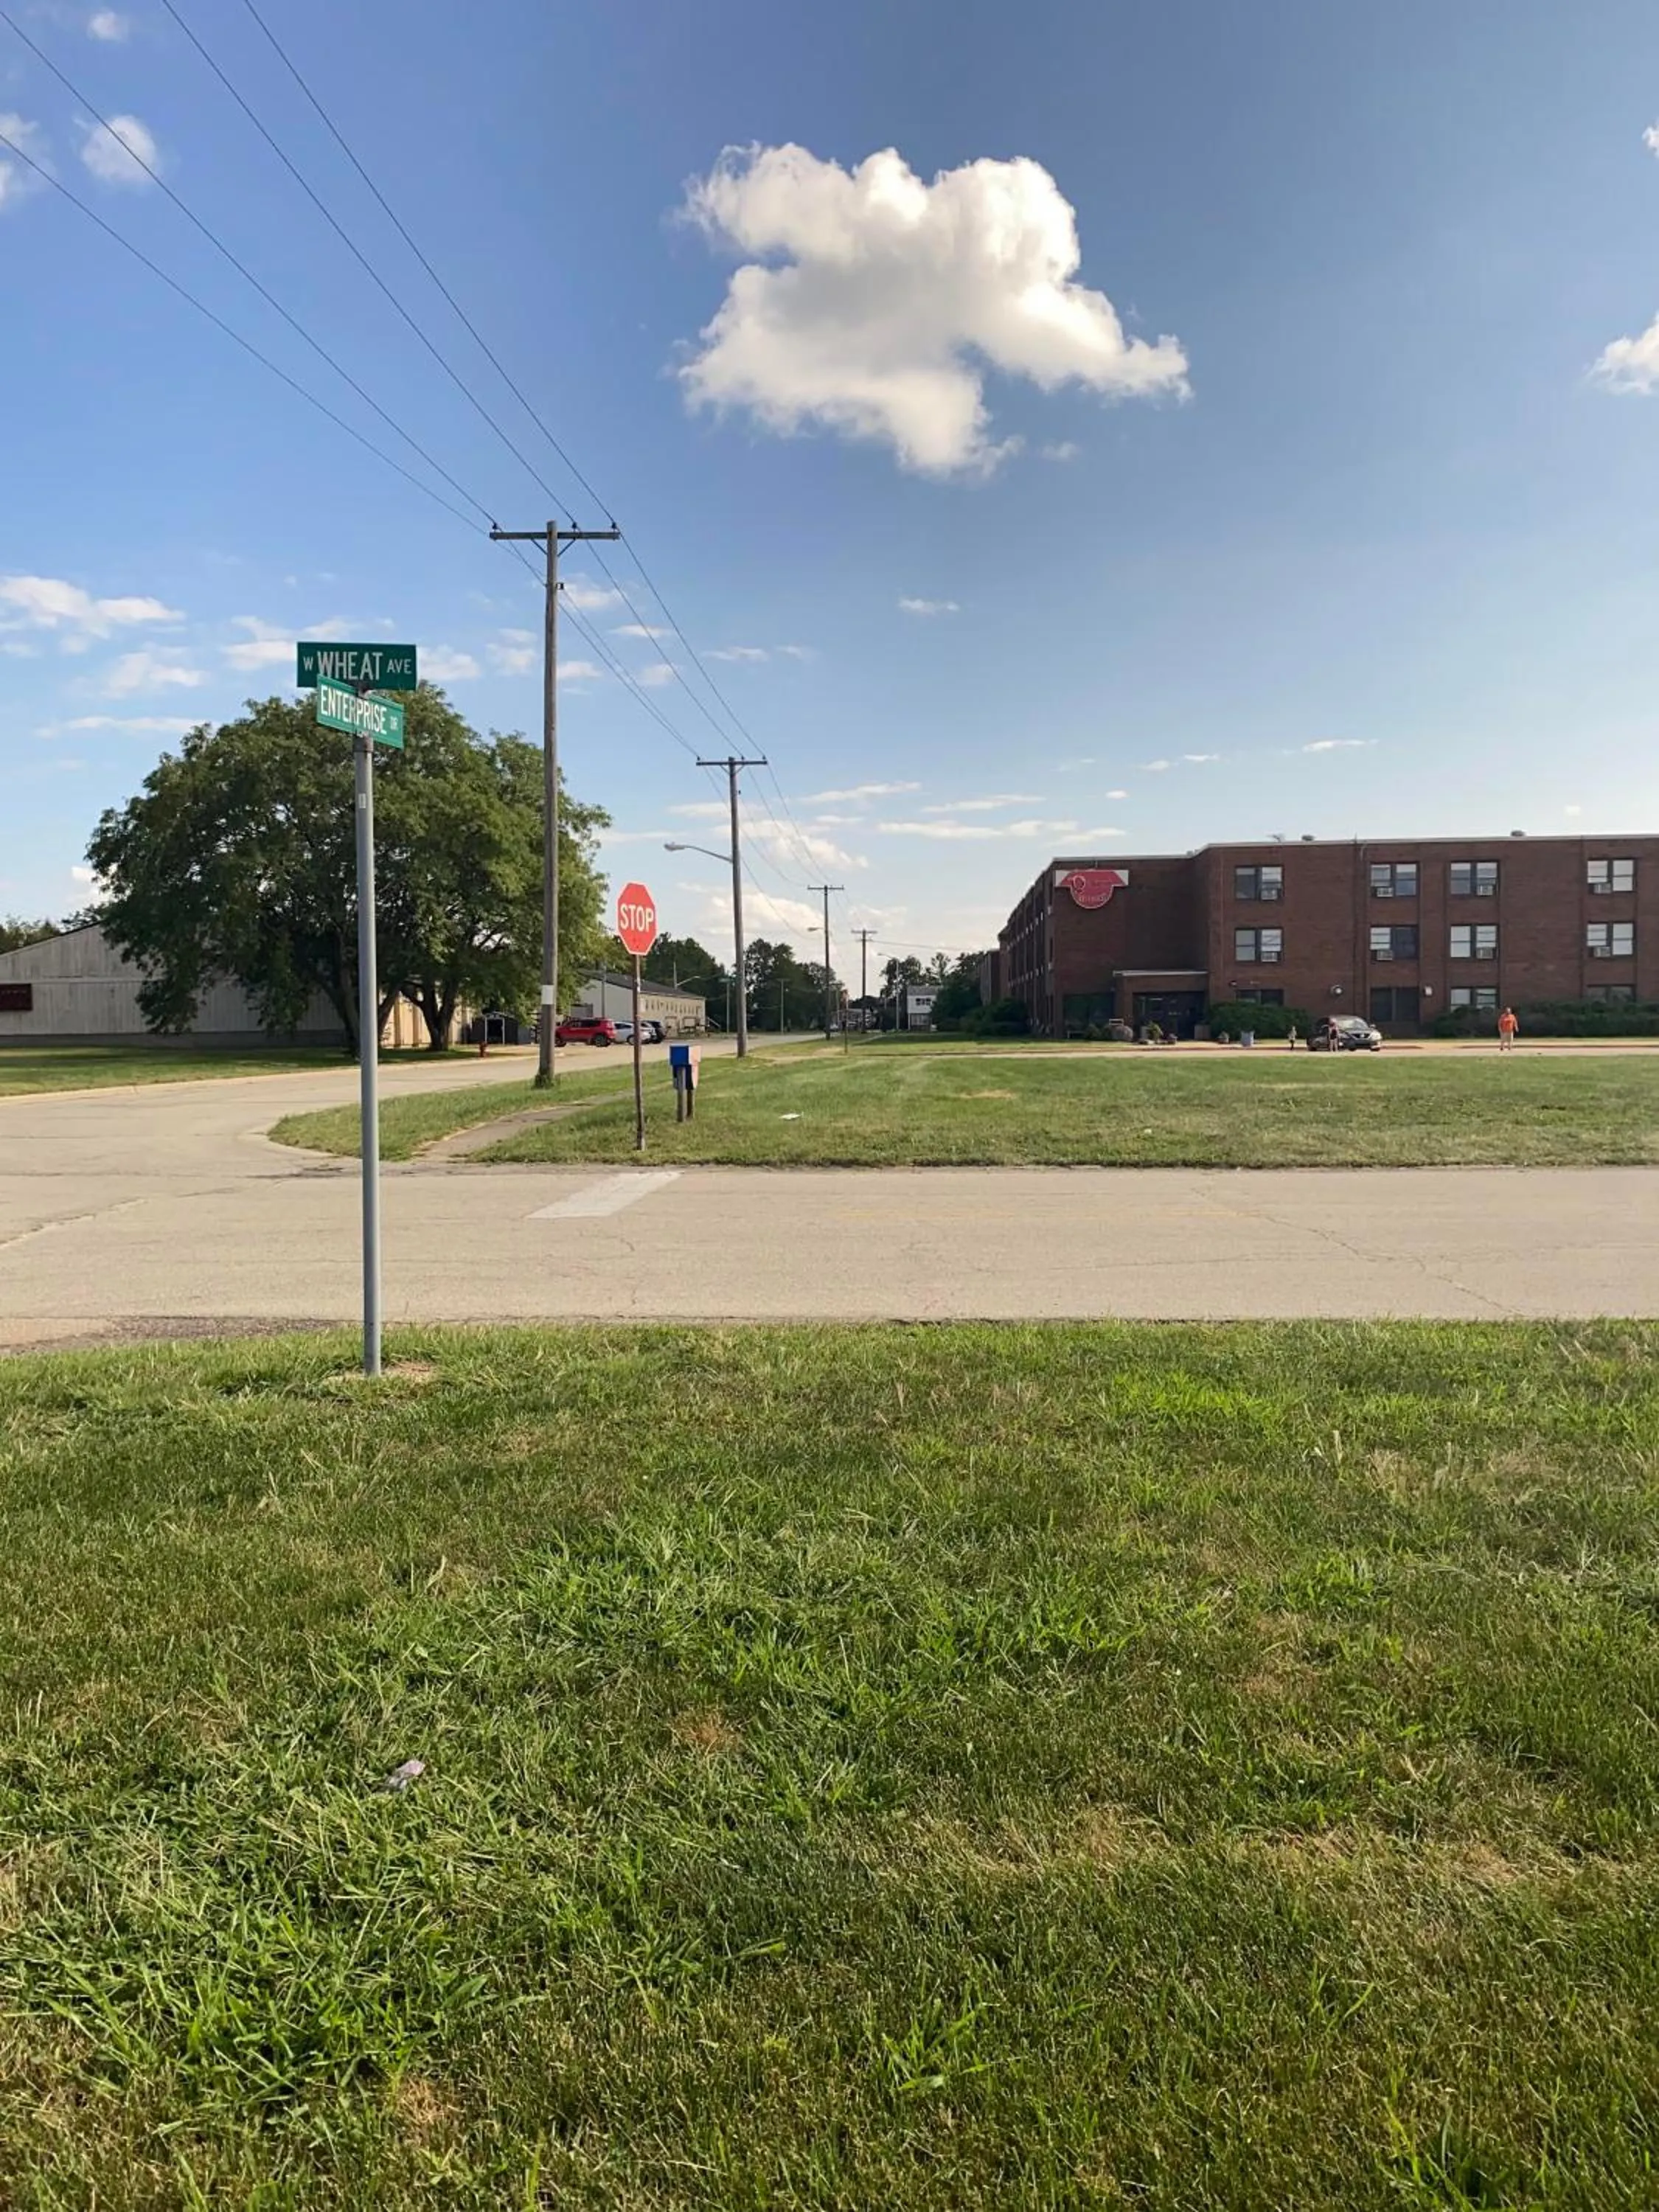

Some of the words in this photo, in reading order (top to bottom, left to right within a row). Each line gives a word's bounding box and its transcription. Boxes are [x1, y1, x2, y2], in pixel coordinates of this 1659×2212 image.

[303, 655, 313, 672] W
[317, 651, 383, 681] WHEAT
[386, 658, 412, 675] AVE
[321, 684, 387, 735] ENTERPRISE
[620, 903, 654, 933] STOP
